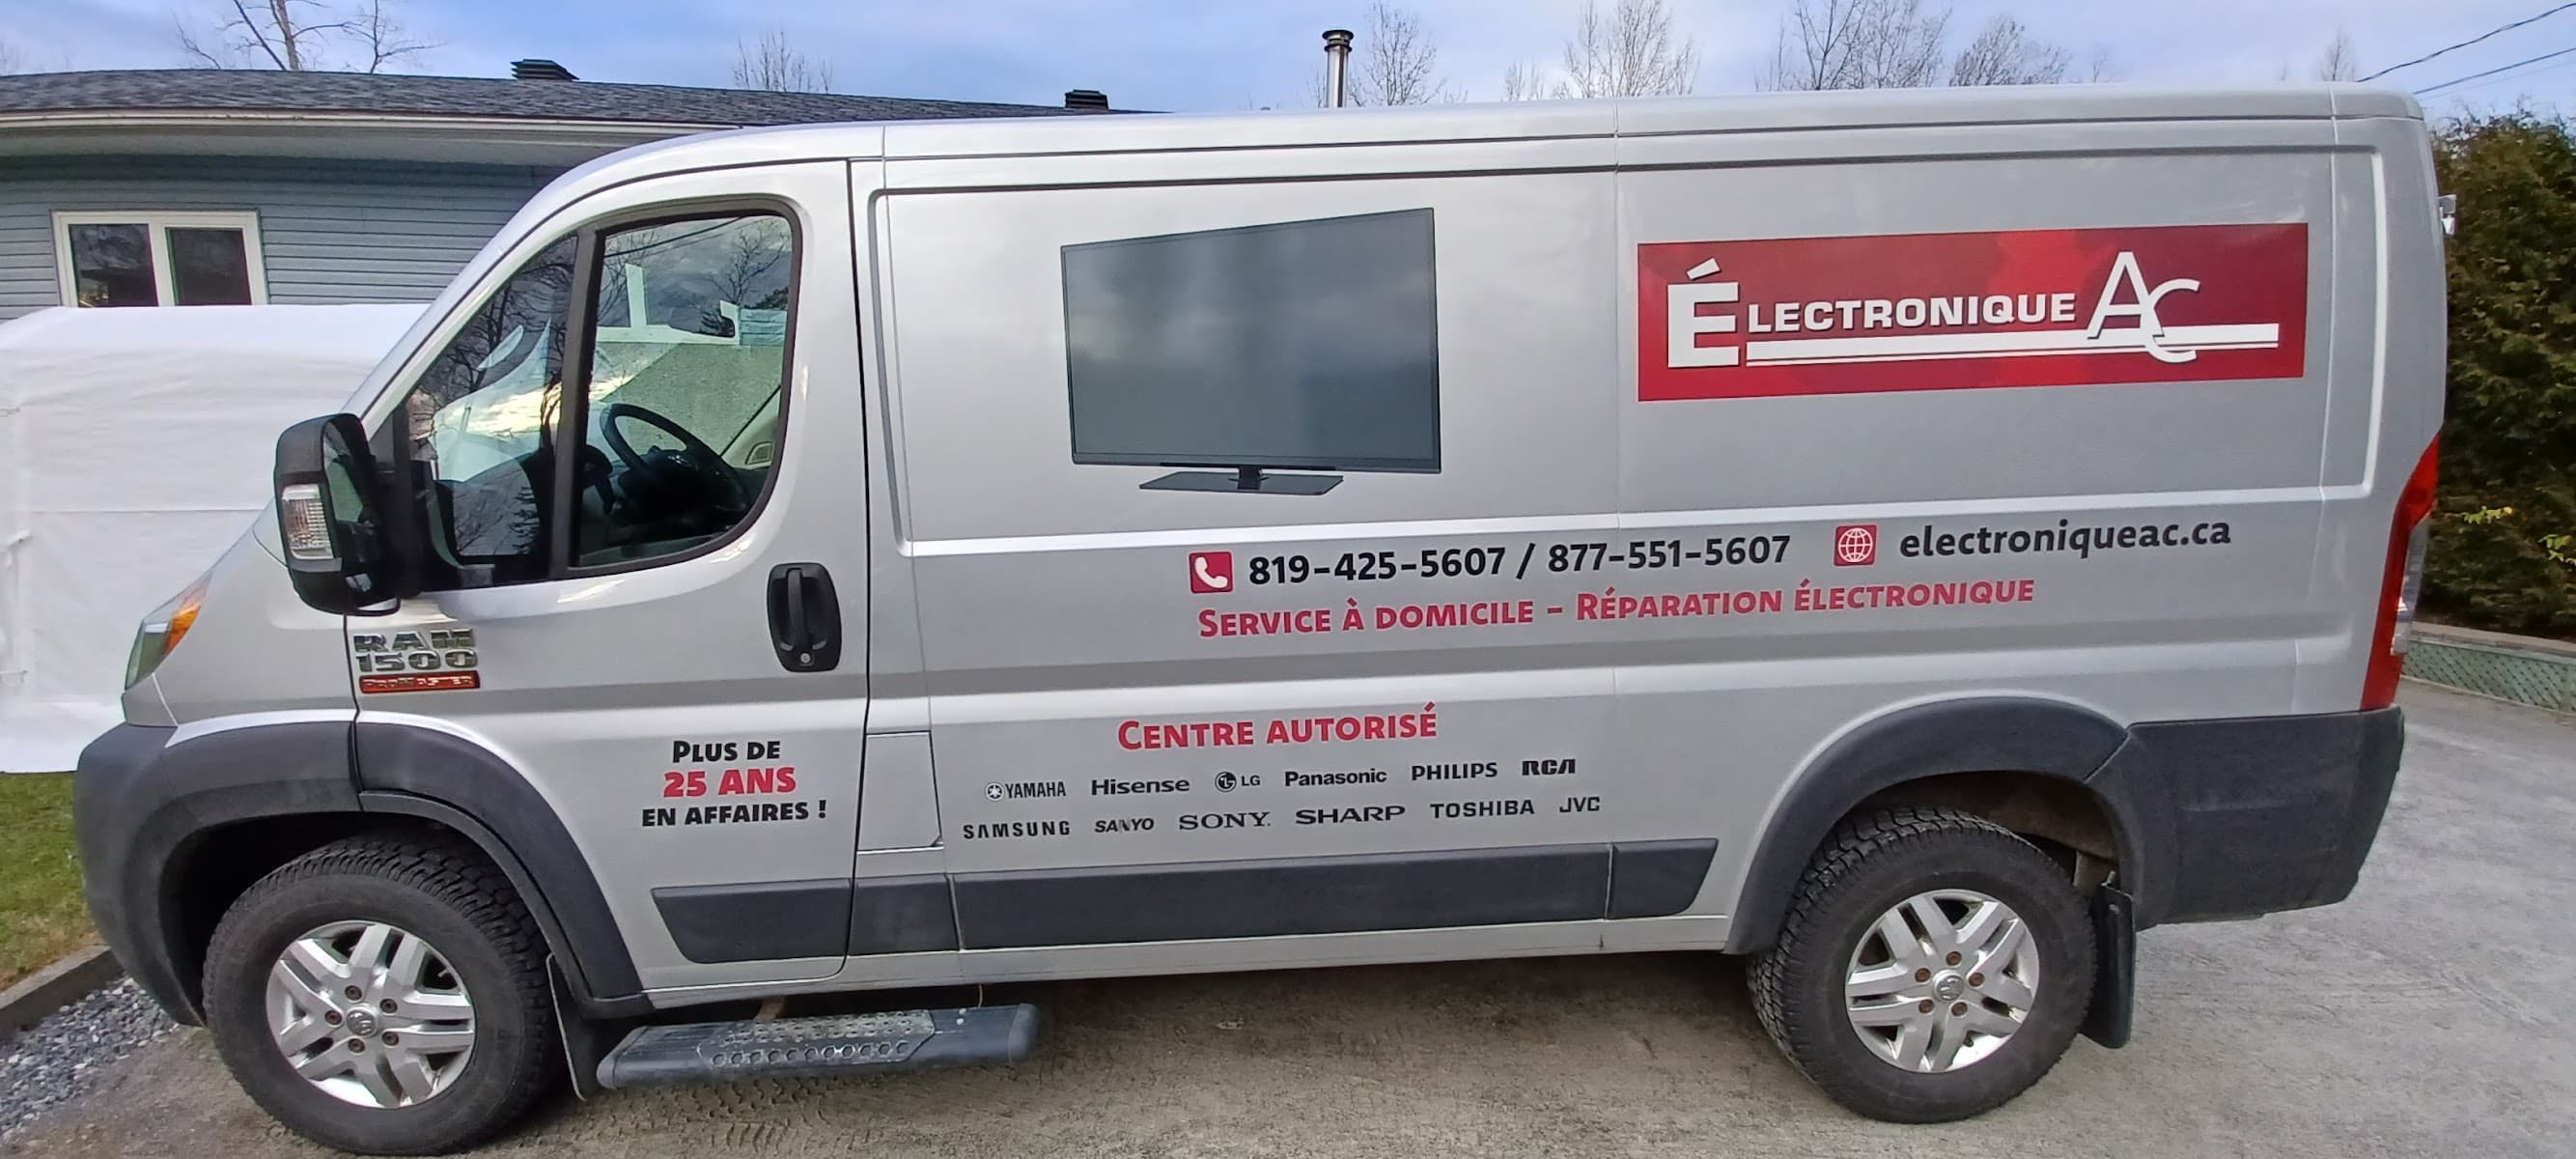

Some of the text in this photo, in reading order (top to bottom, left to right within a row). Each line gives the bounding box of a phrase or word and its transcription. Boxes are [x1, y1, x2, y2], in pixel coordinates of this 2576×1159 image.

[1667, 258, 2076, 369] ÉLECTRONIQUE
[1899, 518, 2232, 558] electroniqueac.ca
[1248, 536, 1792, 585] 819-425-5607 / 877-551-5607
[1198, 607, 1332, 638] SERVICE
[1342, 597, 1365, 632] À
[1375, 599, 1534, 630] DOMICILE
[1576, 585, 1782, 621] RÉPARATION
[1794, 578, 2035, 614] ÉLECTRONIQUE
[353, 630, 474, 652] RAM
[355, 649, 477, 672] 1500
[1117, 702, 1438, 750] CENTRE AUTORISÉ
[672, 740, 781, 763] PLUS DE
[663, 767, 797, 798] 25 ANS
[1005, 758, 1576, 800] YAMAHA Hisense LG Panasonic PHILIPS RCA
[642, 807, 677, 827] EN
[685, 802, 810, 825] AFFAIRES
[963, 820, 1071, 840] SAMSUNG
[1094, 818, 1155, 834] SANYO
[1295, 806, 1407, 826] SHARP
[1430, 800, 1535, 820] TOSHIBA
[1559, 797, 1602, 814] JVC
